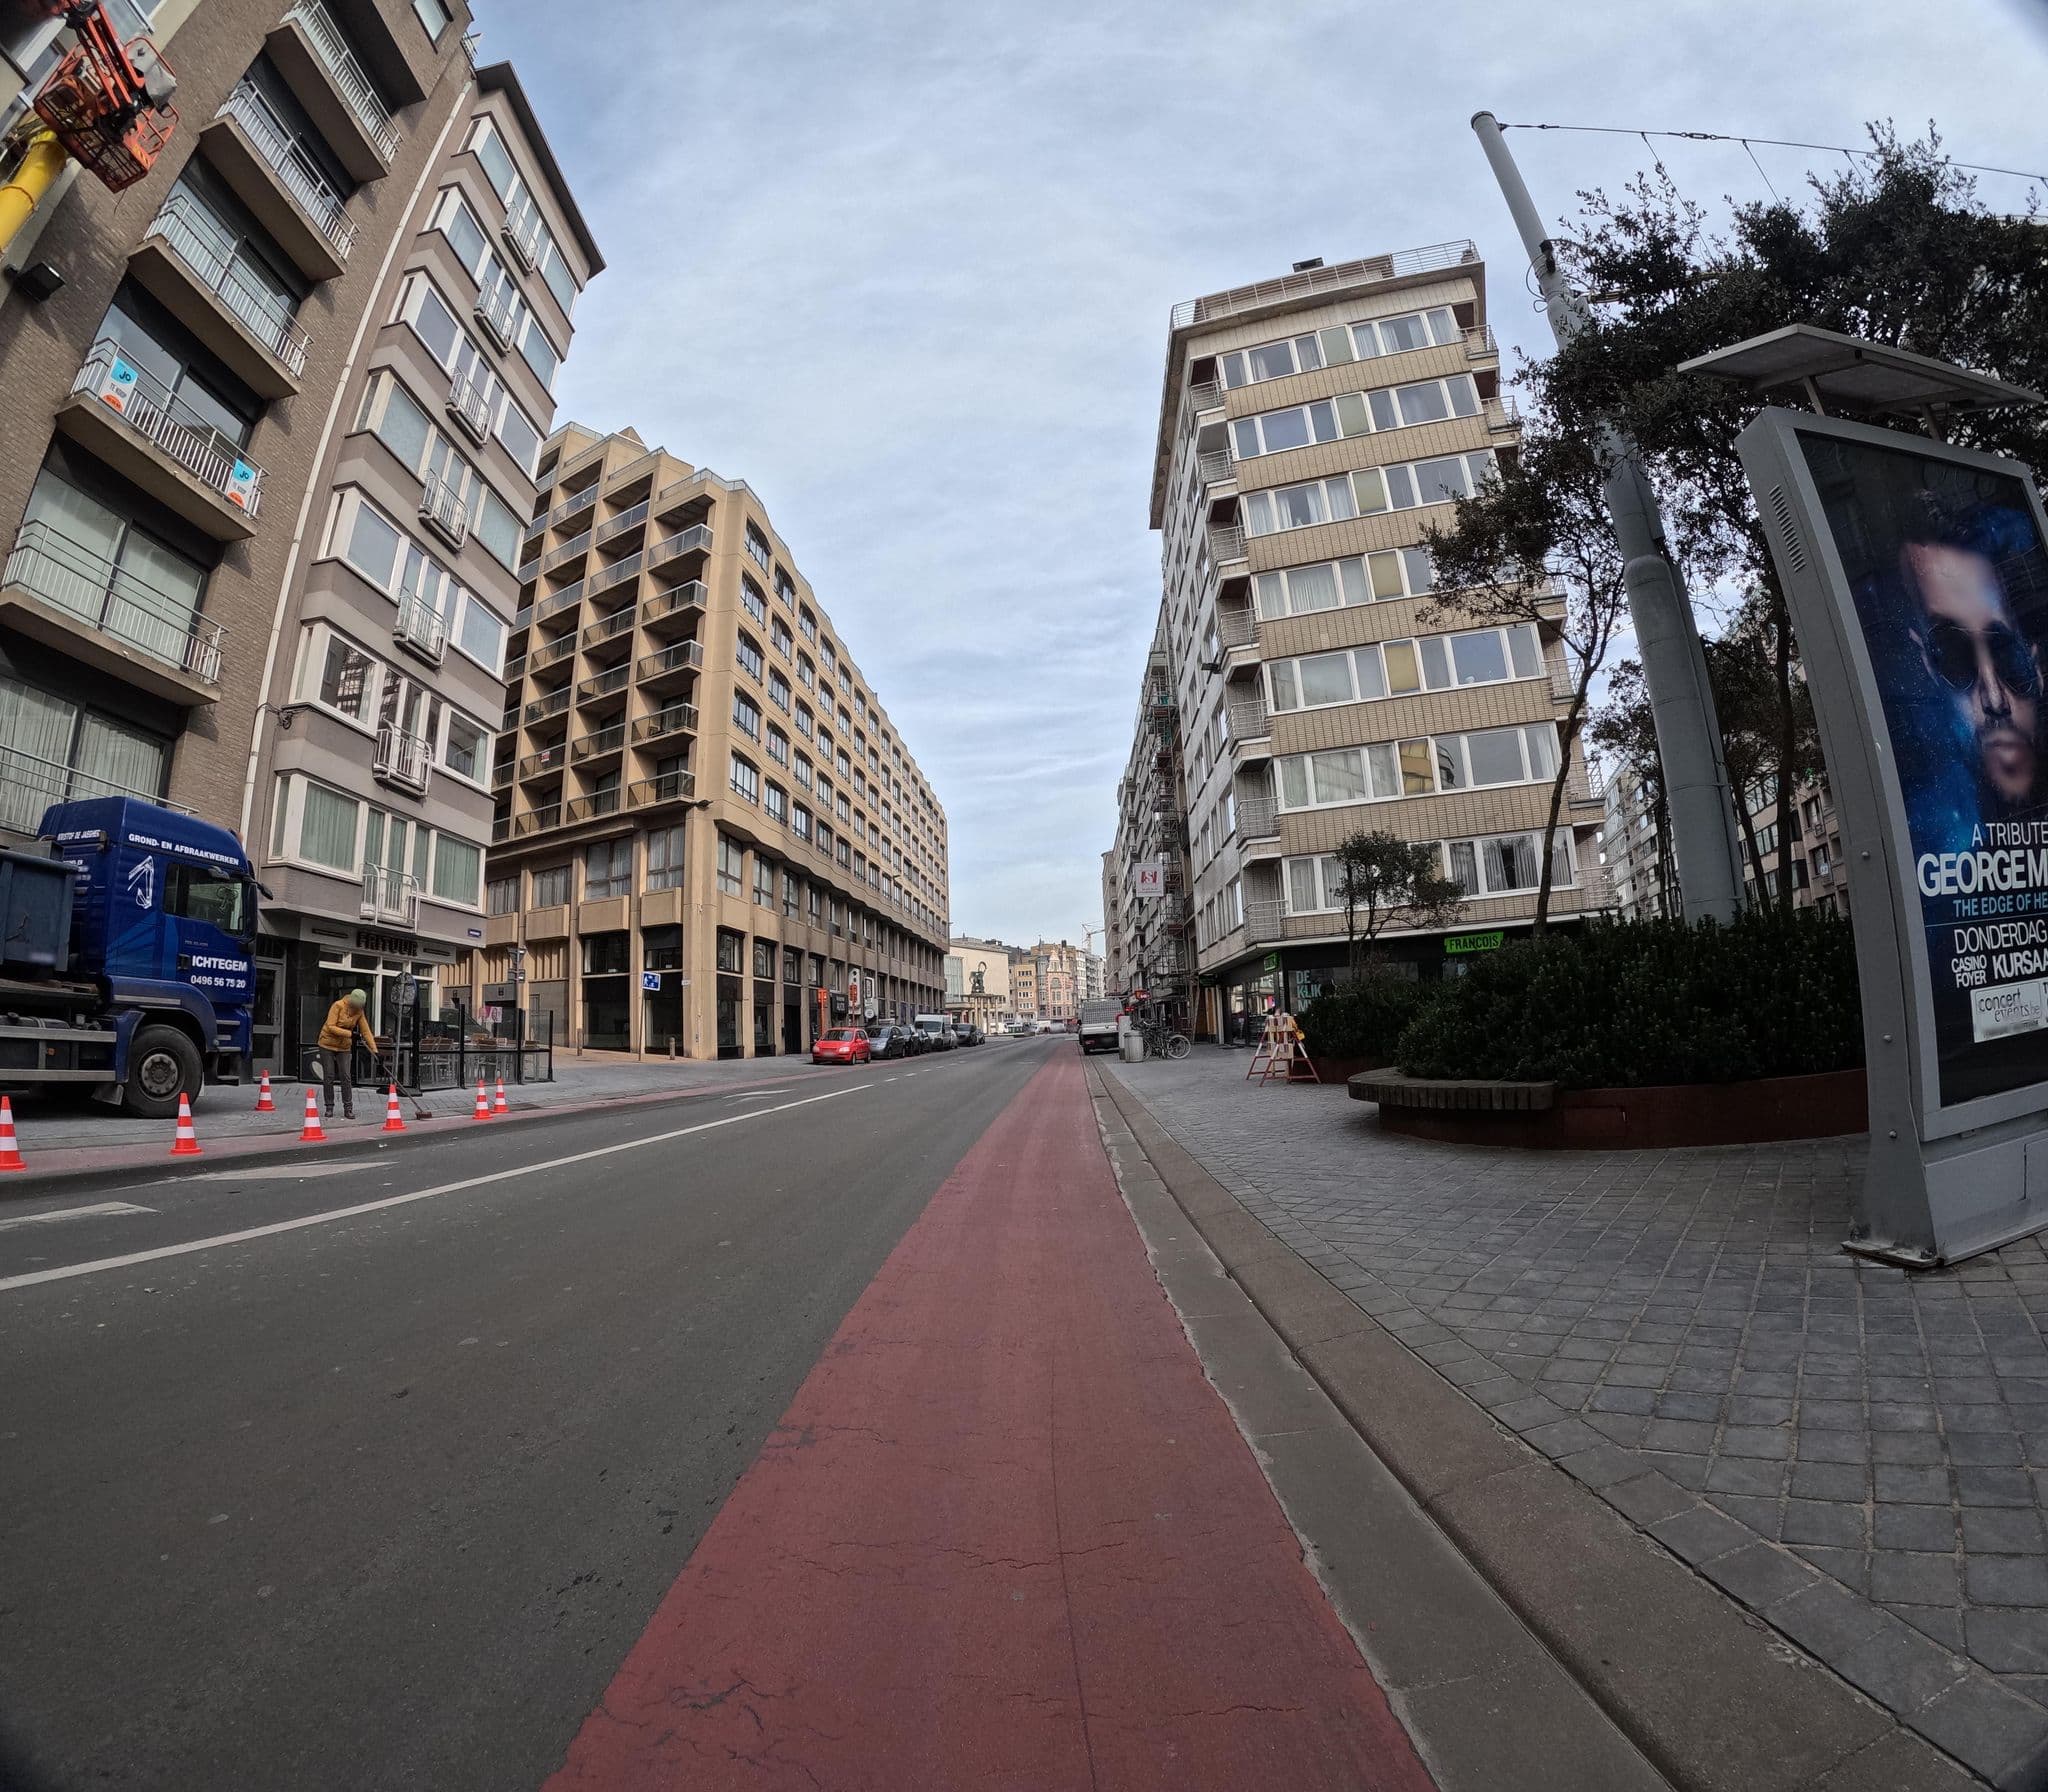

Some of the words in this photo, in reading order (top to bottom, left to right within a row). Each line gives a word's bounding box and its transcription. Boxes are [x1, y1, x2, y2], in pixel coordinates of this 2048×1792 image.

[1971, 823, 1984, 847] A
[1985, 821, 2048, 847] TRIBUTE
[128, 833, 160, 847] GROND-
[161, 840, 173, 851] EN
[174, 844, 240, 866] AFBRAAKWERKEN
[1917, 850, 2026, 897] GEORGE
[1952, 897, 1979, 918] THE
[1981, 894, 2014, 915] EDGE
[2016, 892, 2031, 911] OF
[1953, 919, 2048, 954] DONDERDAG
[191, 955, 248, 972] ICHTEGEM
[1951, 954, 1987, 973] CASINO
[190, 975, 213, 985] 0496
[213, 977, 225, 987] 56
[225, 978, 235, 988] 75
[235, 979, 247, 989] 20
[1295, 969, 1311, 985] DE
[1955, 970, 1987, 988] FOYER
[1296, 983, 1323, 999] KLIK
[1978, 987, 2022, 1013] concert
